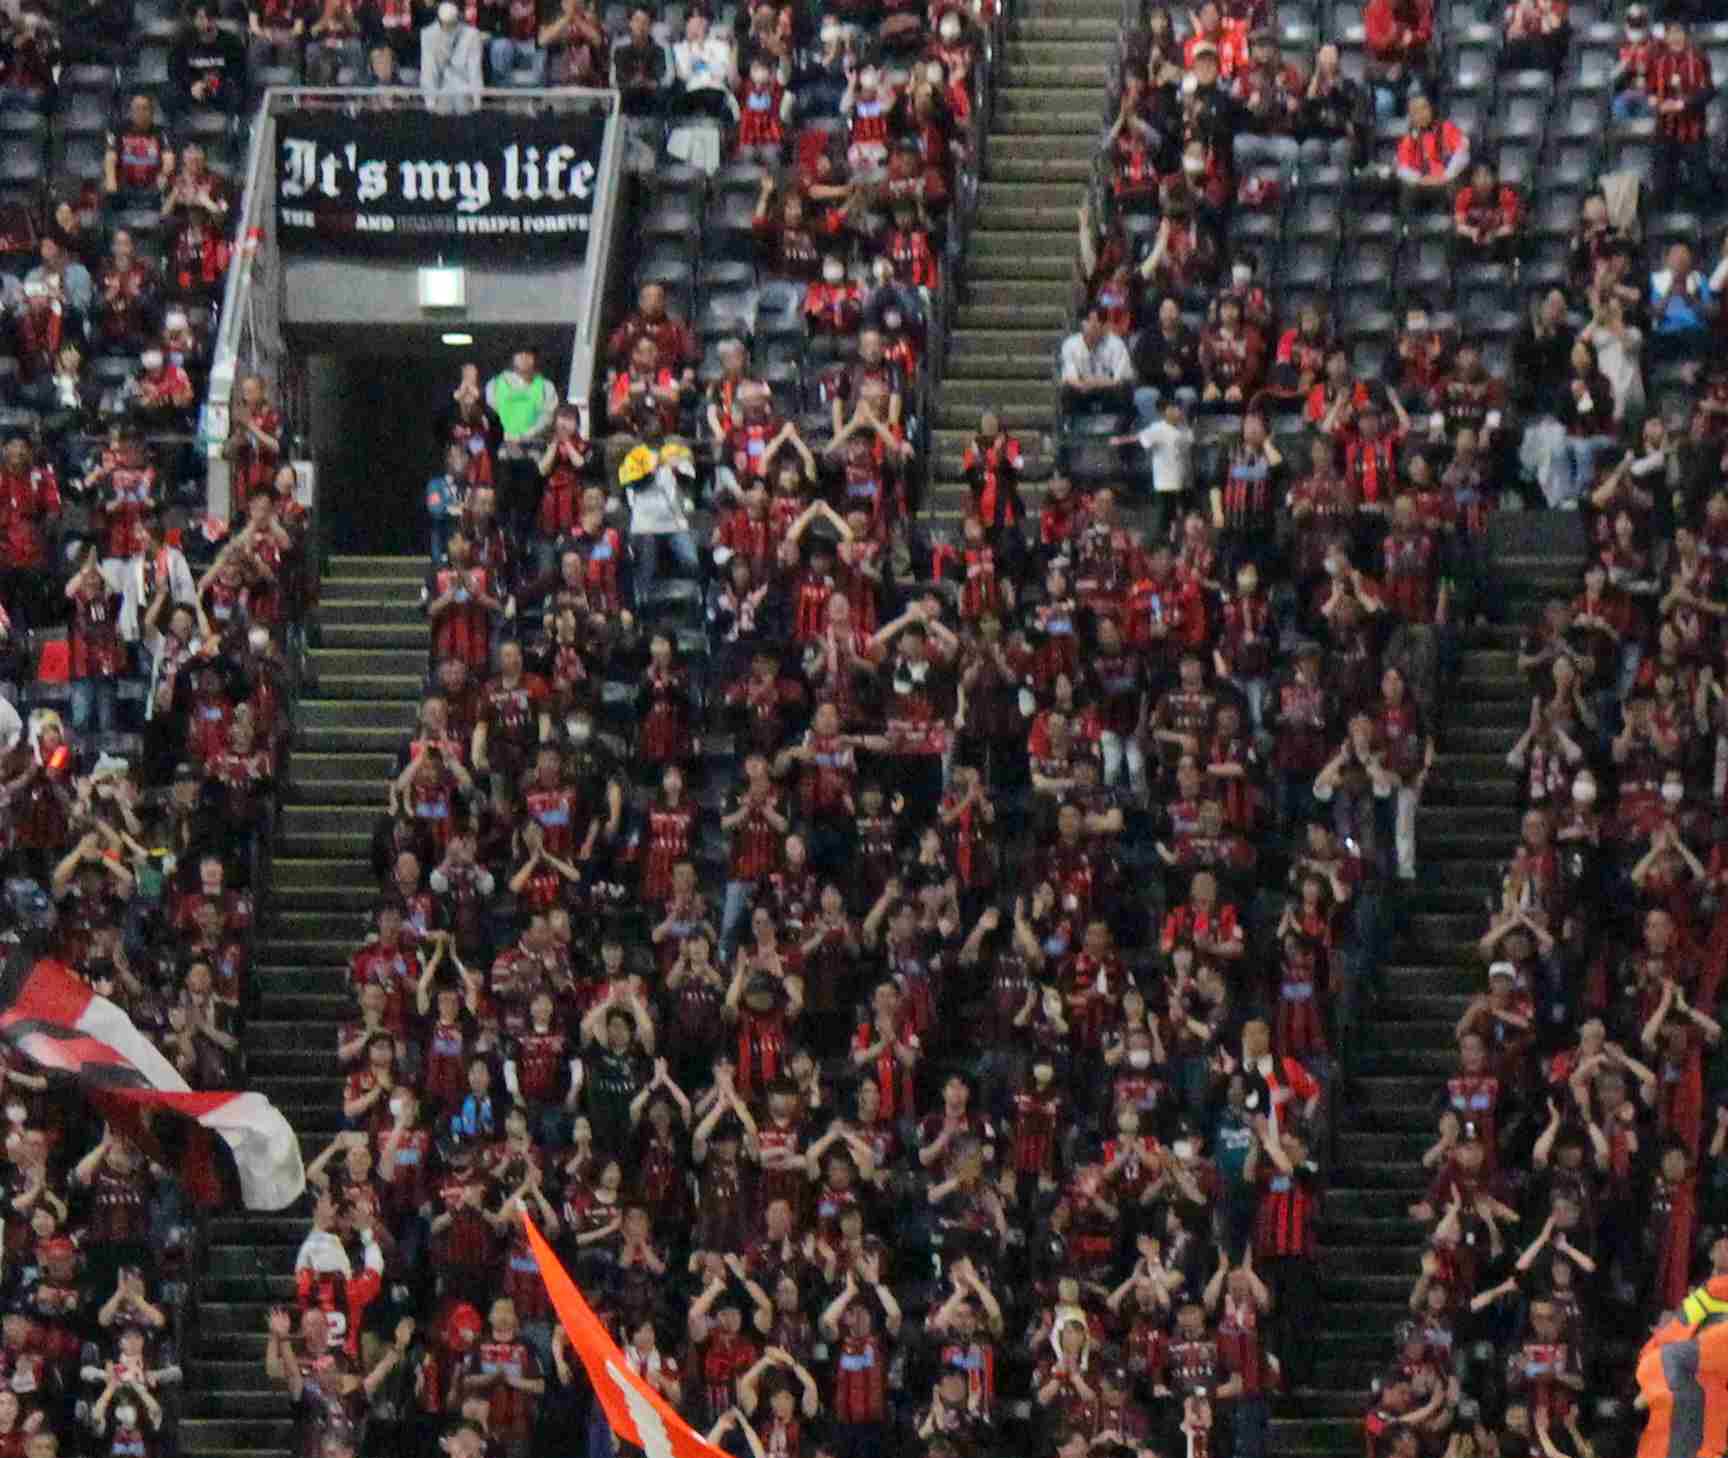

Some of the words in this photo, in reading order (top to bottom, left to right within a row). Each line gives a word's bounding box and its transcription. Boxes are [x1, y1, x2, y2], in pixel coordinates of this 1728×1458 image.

[281, 137, 388, 205] It's
[399, 158, 493, 214] my
[502, 143, 596, 201] life
[355, 212, 395, 232] AND
[523, 214, 592, 232] FOREVE
